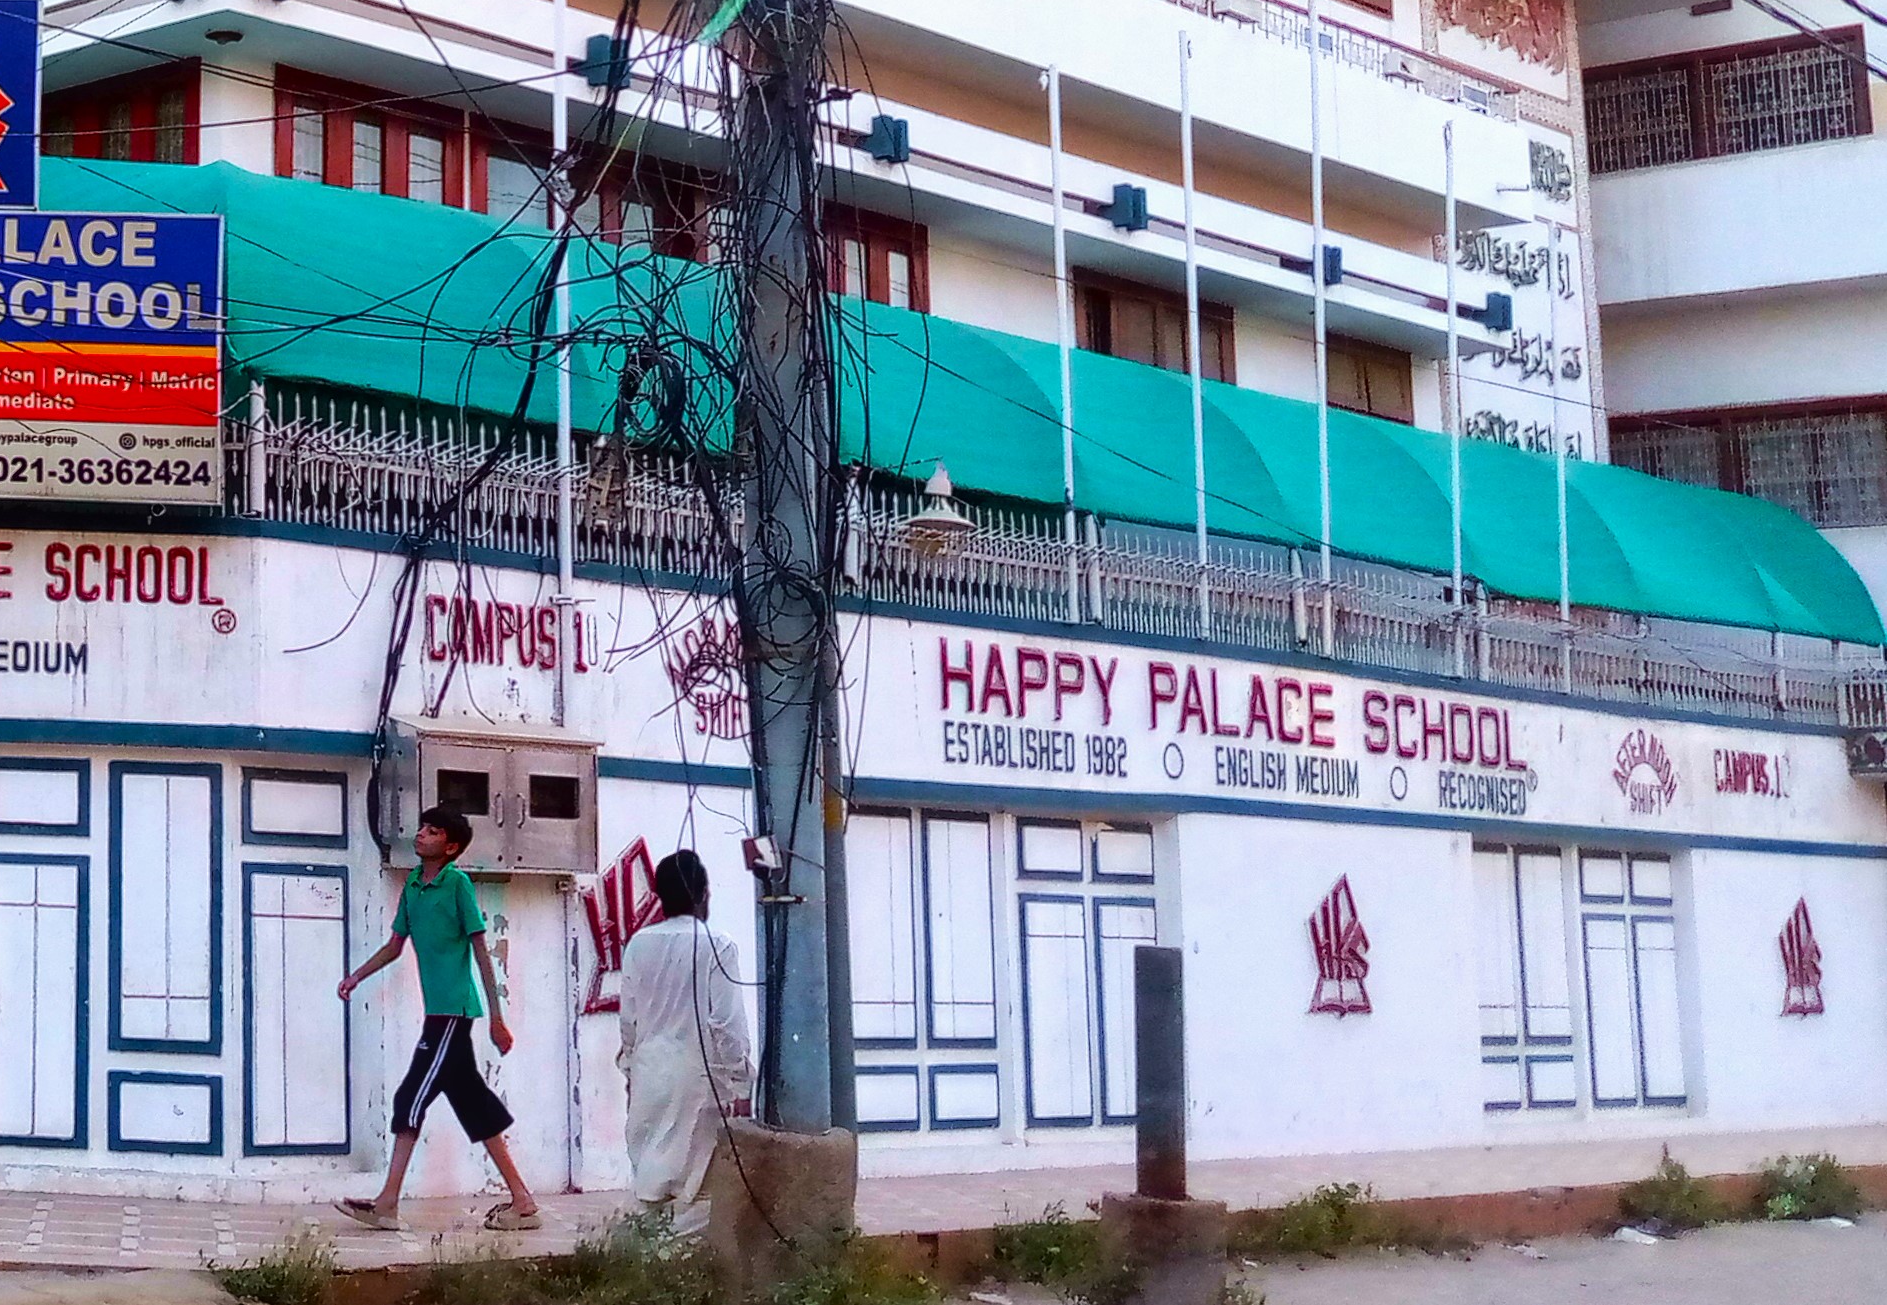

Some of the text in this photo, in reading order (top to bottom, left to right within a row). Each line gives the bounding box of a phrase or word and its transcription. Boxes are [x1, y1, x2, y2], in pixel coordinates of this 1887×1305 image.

[53, 368, 133, 392] Primary
[150, 370, 215, 391] Matric
[142, 435, 215, 449] hpgs_official
[44, 541, 224, 607] SCHOOL
[426, 593, 557, 670] CAMPUS
[939, 636, 1119, 726] HAPPY
[1149, 661, 1336, 749] PALACE
[1362, 688, 1528, 773] SCHOOL
[943, 720, 1527, 816] ESTABLISHED 1982 ENGLISH MEDIUM RECOGNISED
